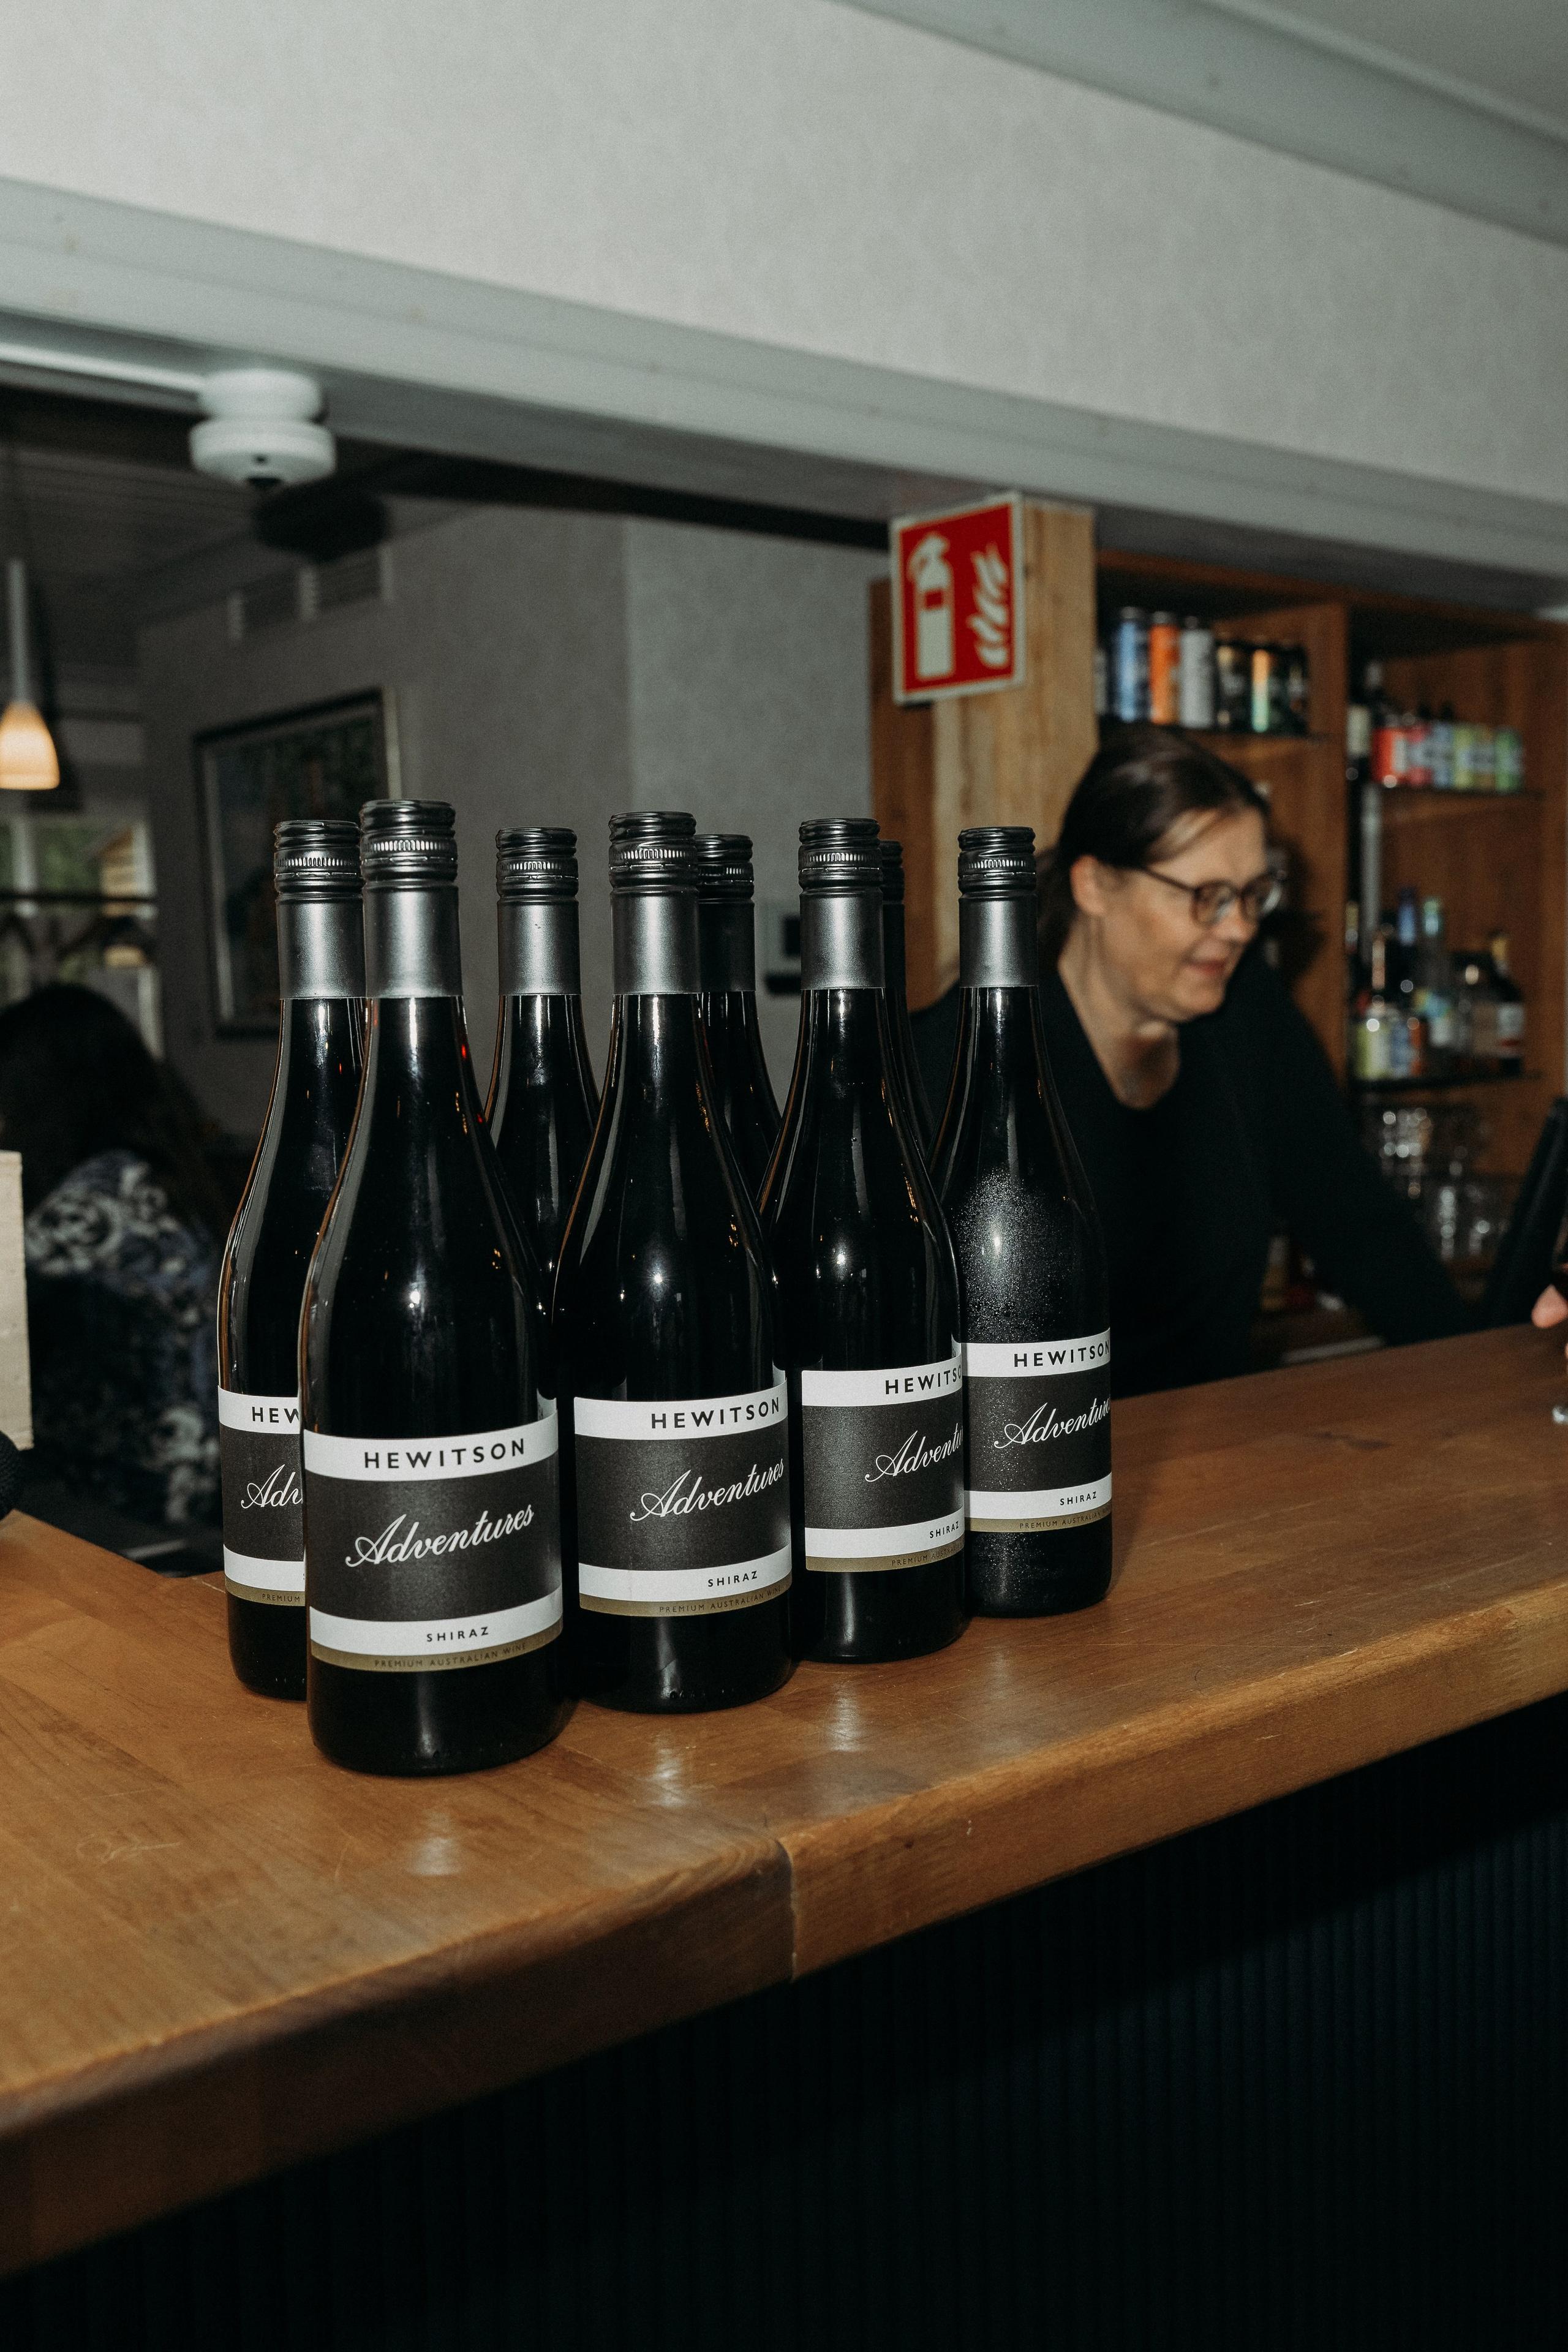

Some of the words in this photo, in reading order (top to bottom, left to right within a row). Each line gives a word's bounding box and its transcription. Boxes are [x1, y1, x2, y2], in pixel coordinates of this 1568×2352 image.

[1014, 1340, 1109, 1367] HEWITSON
[651, 1396, 780, 1429] HEWITSON
[364, 1438, 525, 1469] HEWITSON
[630, 1458, 785, 1521] Adventures
[1060, 1491, 1097, 1506] SHIRAZ
[929, 1520, 959, 1539] SHIRAZ
[1020, 1520, 1058, 1529] PREMIUM
[345, 1504, 534, 1568] Adventures
[891, 1555, 928, 1566] PREMIUM
[707, 1570, 758, 1587] SHIRAZ
[262, 1593, 300, 1602] PREMIUM
[659, 1604, 704, 1613] PREMIUM
[710, 1593, 764, 1610] AUSTRALIAN
[766, 1585, 782, 1597] WINE
[426, 1626, 489, 1642] SHIRAZ
[374, 1659, 423, 1668] PREMIUM
[429, 1650, 499, 1667] AUSTRALIAN
[502, 1642, 527, 1654] WINE
